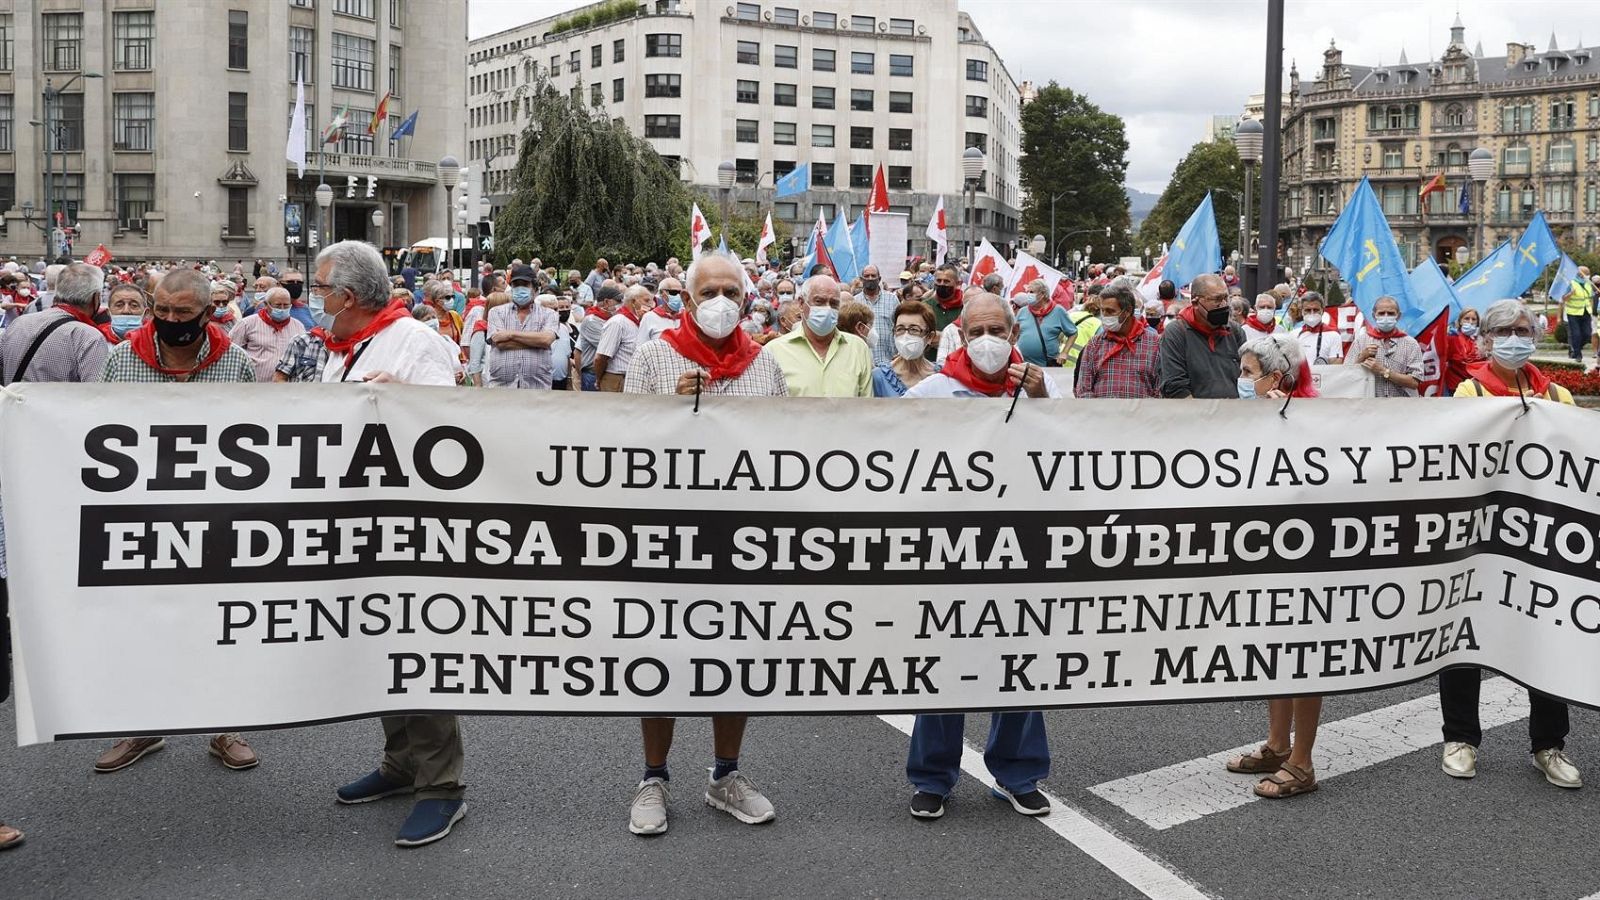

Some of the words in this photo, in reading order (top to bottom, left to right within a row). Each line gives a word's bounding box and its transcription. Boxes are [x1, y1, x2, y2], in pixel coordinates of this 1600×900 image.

[81, 423, 485, 493] SESTAO
[536, 444, 1008, 499] JUBILADOS/AS,
[1026, 446, 1330, 492] VIUDOS/AS
[1340, 446, 1372, 485] Y
[1386, 439, 1600, 497] PENSION
[102, 521, 210, 570] EN
[230, 516, 562, 568] DEFENSA
[580, 523, 713, 570] DEL
[731, 526, 1029, 571] SISTEMA
[1045, 514, 1315, 569] PÚBLICO
[1329, 515, 1400, 558] DE
[1413, 504, 1600, 570] PENSIO
[216, 592, 592, 646] PENSIONES
[612, 597, 853, 641] DIGNAS
[914, 582, 1406, 640] MANTENIMIENTO
[1417, 567, 1483, 616] DEL
[387, 652, 670, 698] PENTSIO
[689, 655, 941, 698] DUINAK
[998, 650, 1132, 693] K.P.I.
[1149, 616, 1481, 686] MANTENTZEA
